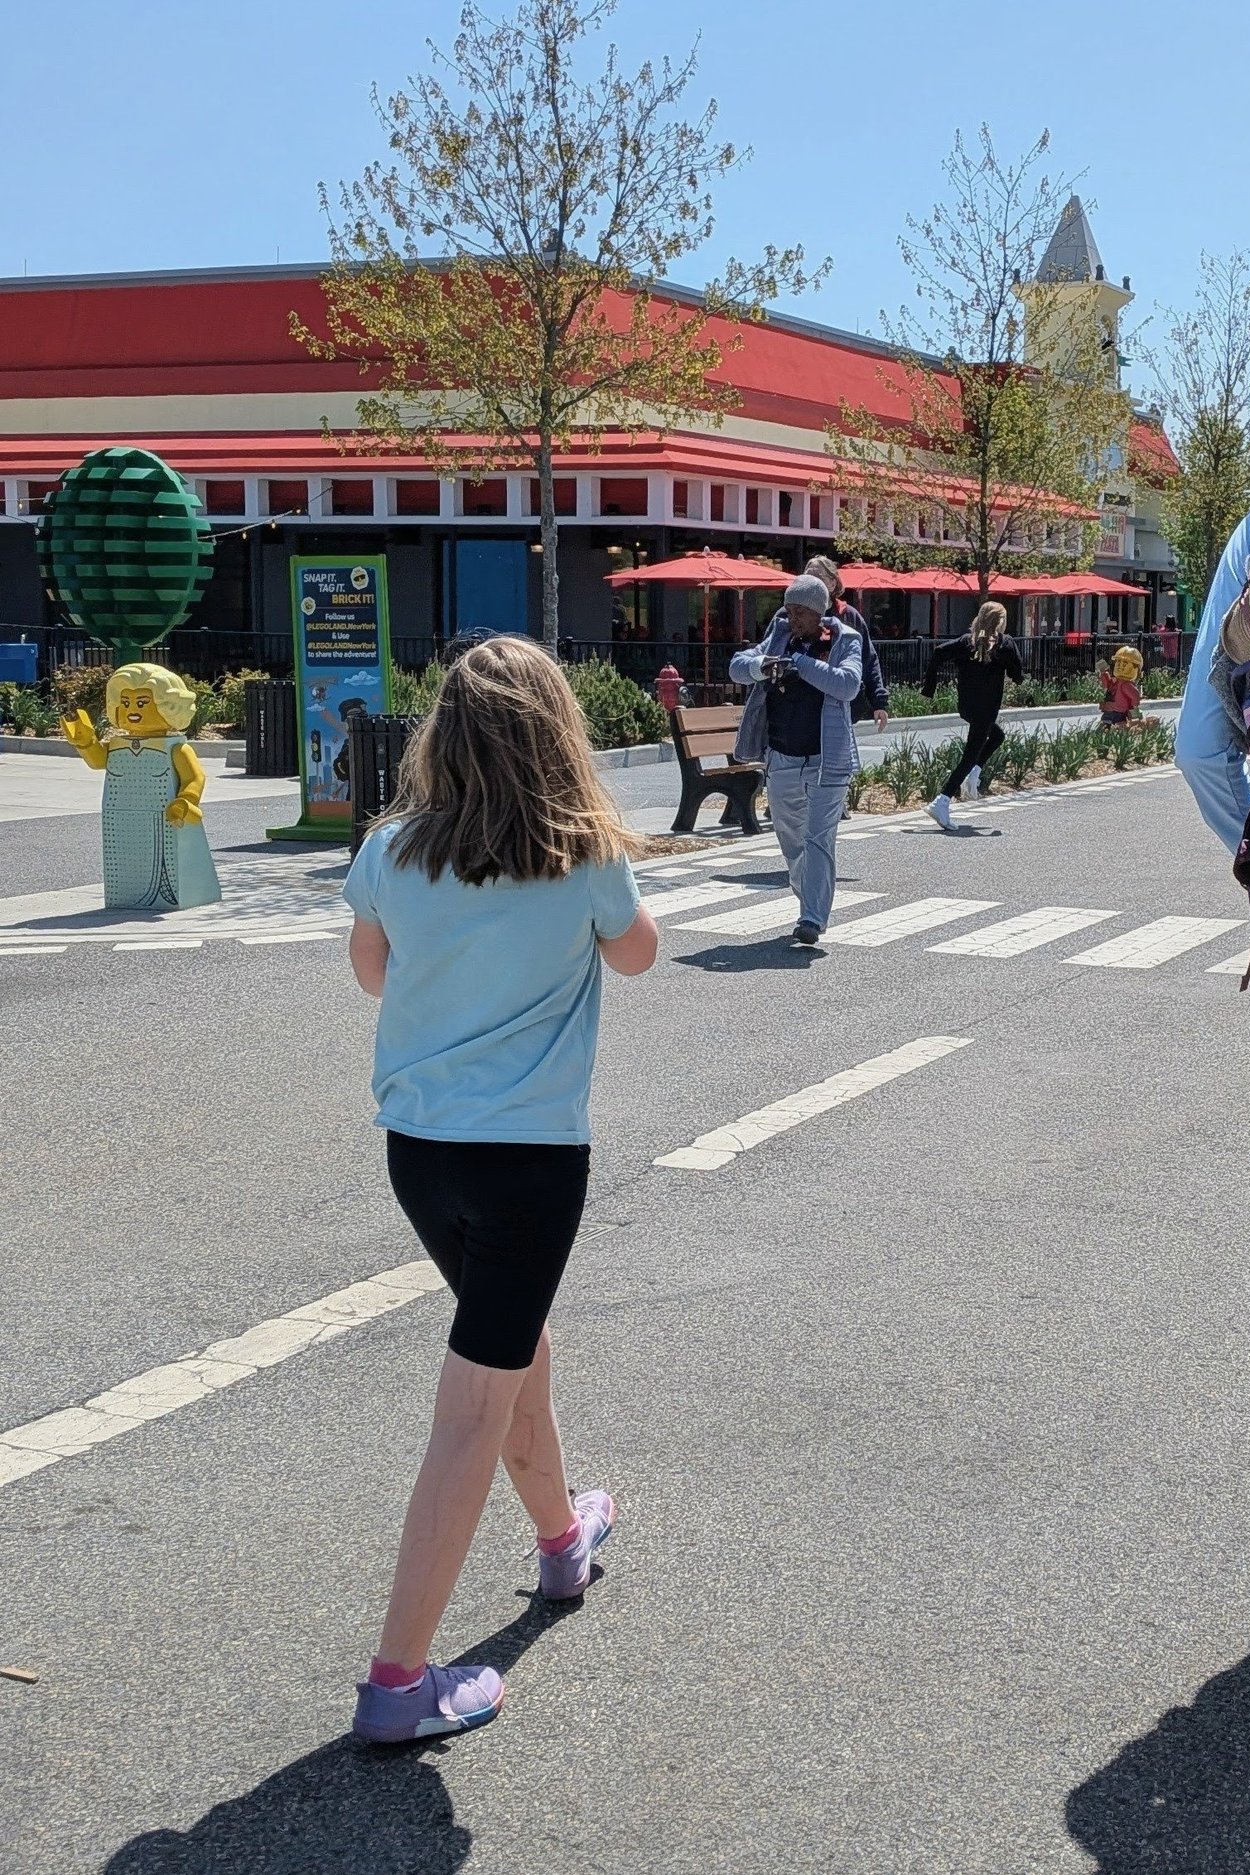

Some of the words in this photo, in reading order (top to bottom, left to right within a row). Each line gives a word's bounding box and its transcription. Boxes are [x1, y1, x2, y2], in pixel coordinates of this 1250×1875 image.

[303, 573, 327, 583] SNAP
[328, 573, 337, 583] IT.
[318, 583, 335, 592] TAG
[336, 583, 345, 592] IT.
[331, 594, 361, 604] BRICK
[362, 594, 375, 604] IT!
